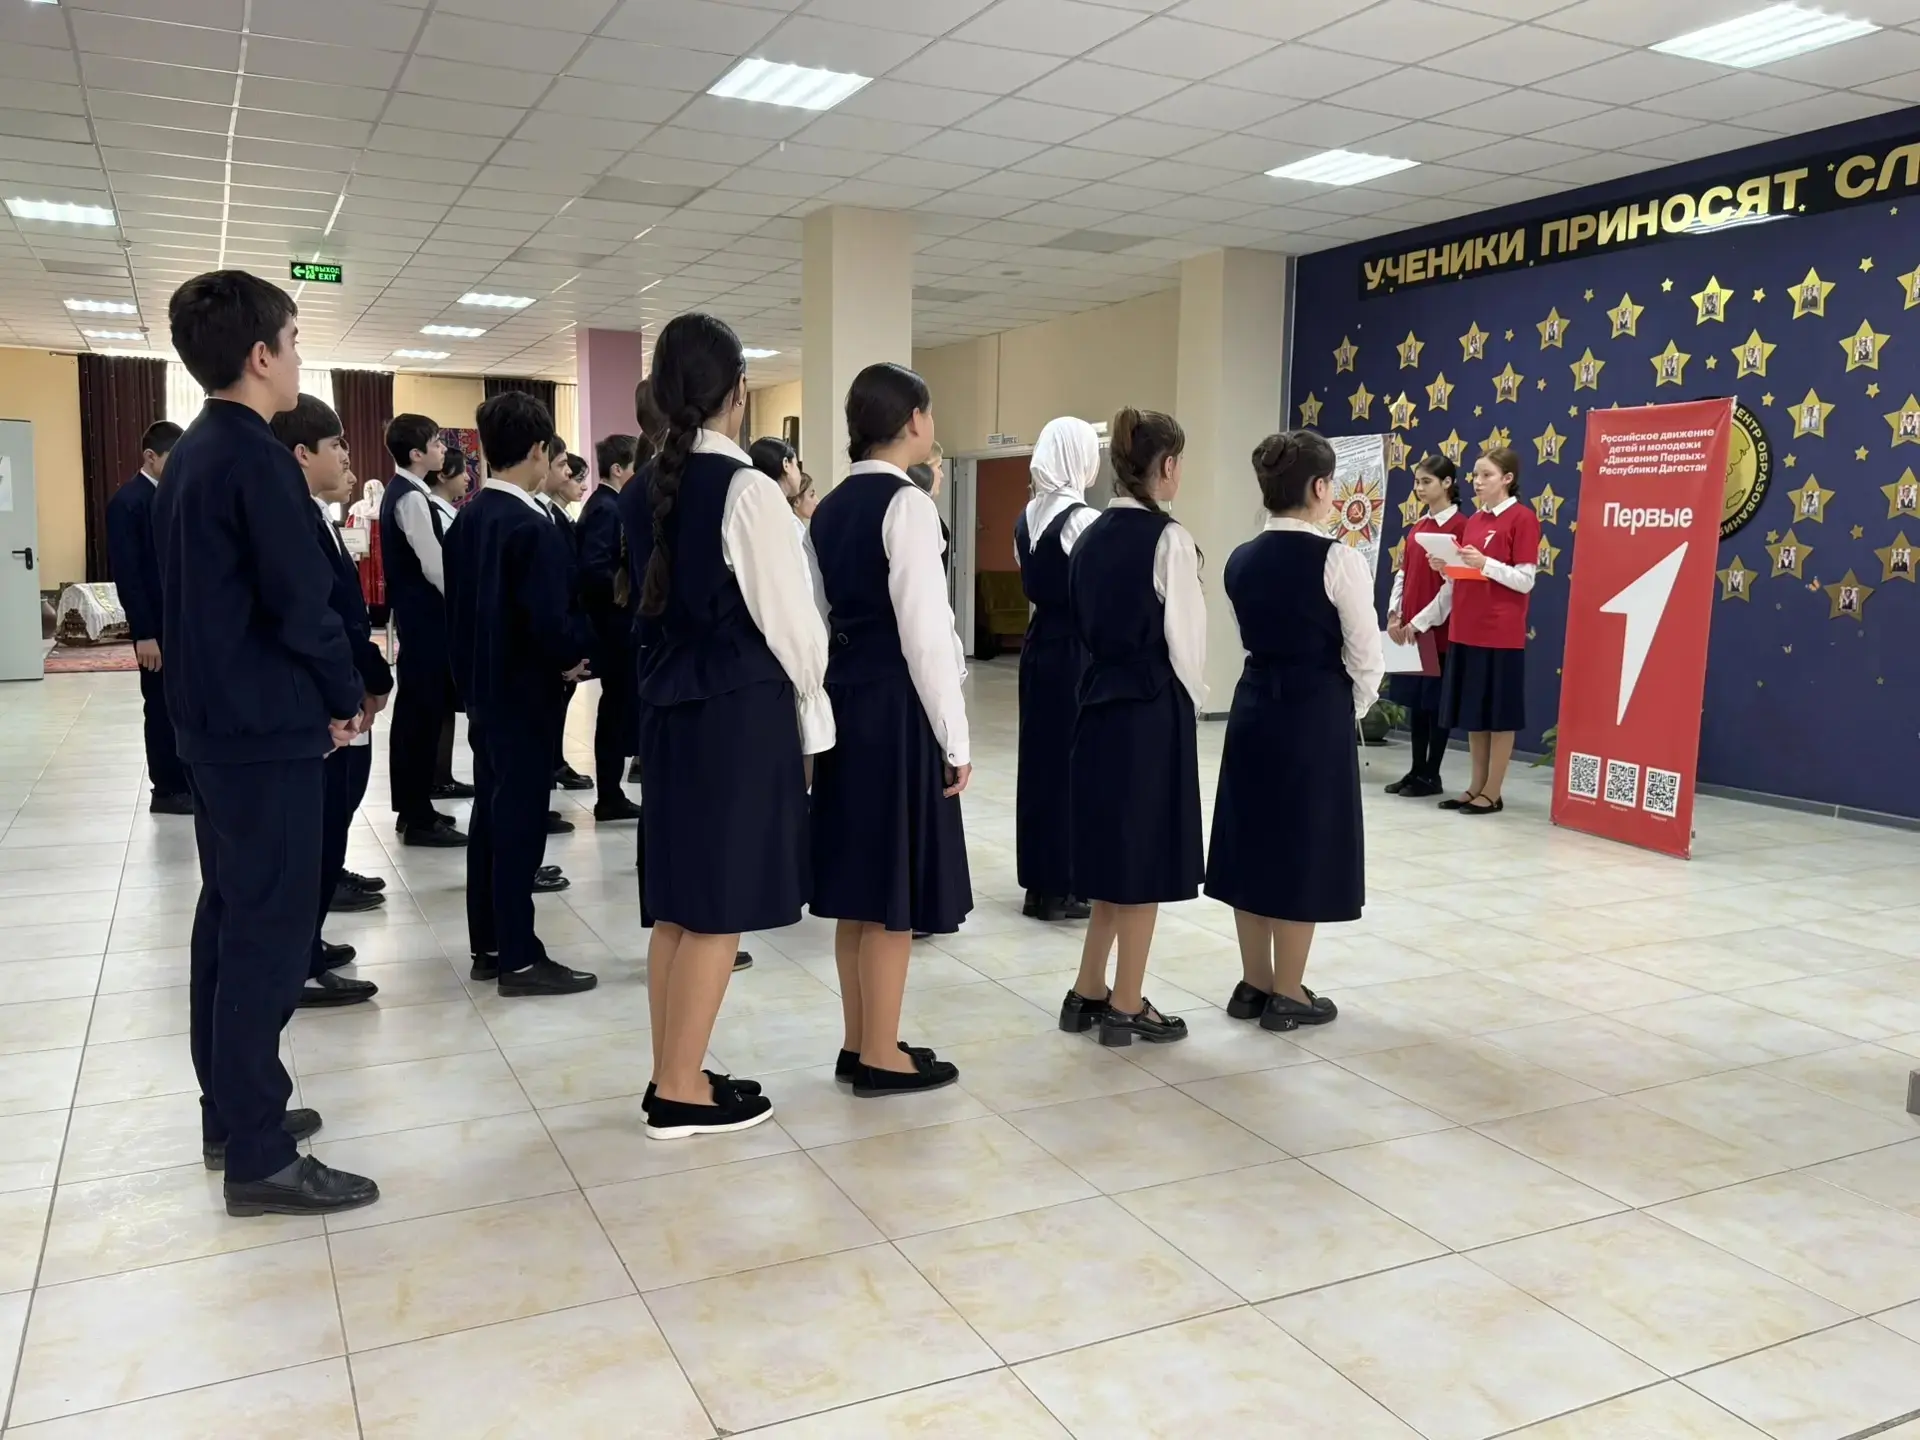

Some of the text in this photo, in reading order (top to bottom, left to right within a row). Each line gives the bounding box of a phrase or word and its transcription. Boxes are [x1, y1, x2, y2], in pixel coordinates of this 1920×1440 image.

[1364, 228, 1527, 290] УЧЕНИКИ
[1540, 167, 1808, 256] ПРИНОСЯТ
[318, 273, 337, 281] EXIT
[1733, 405, 1762, 438] ЕНТР
[1600, 428, 1715, 443] Российское движение
[1608, 443, 1638, 454] детей
[1647, 440, 1702, 452] молодежи
[1599, 463, 1708, 476] Республики Дагестан
[1603, 502, 1693, 535] Первые
